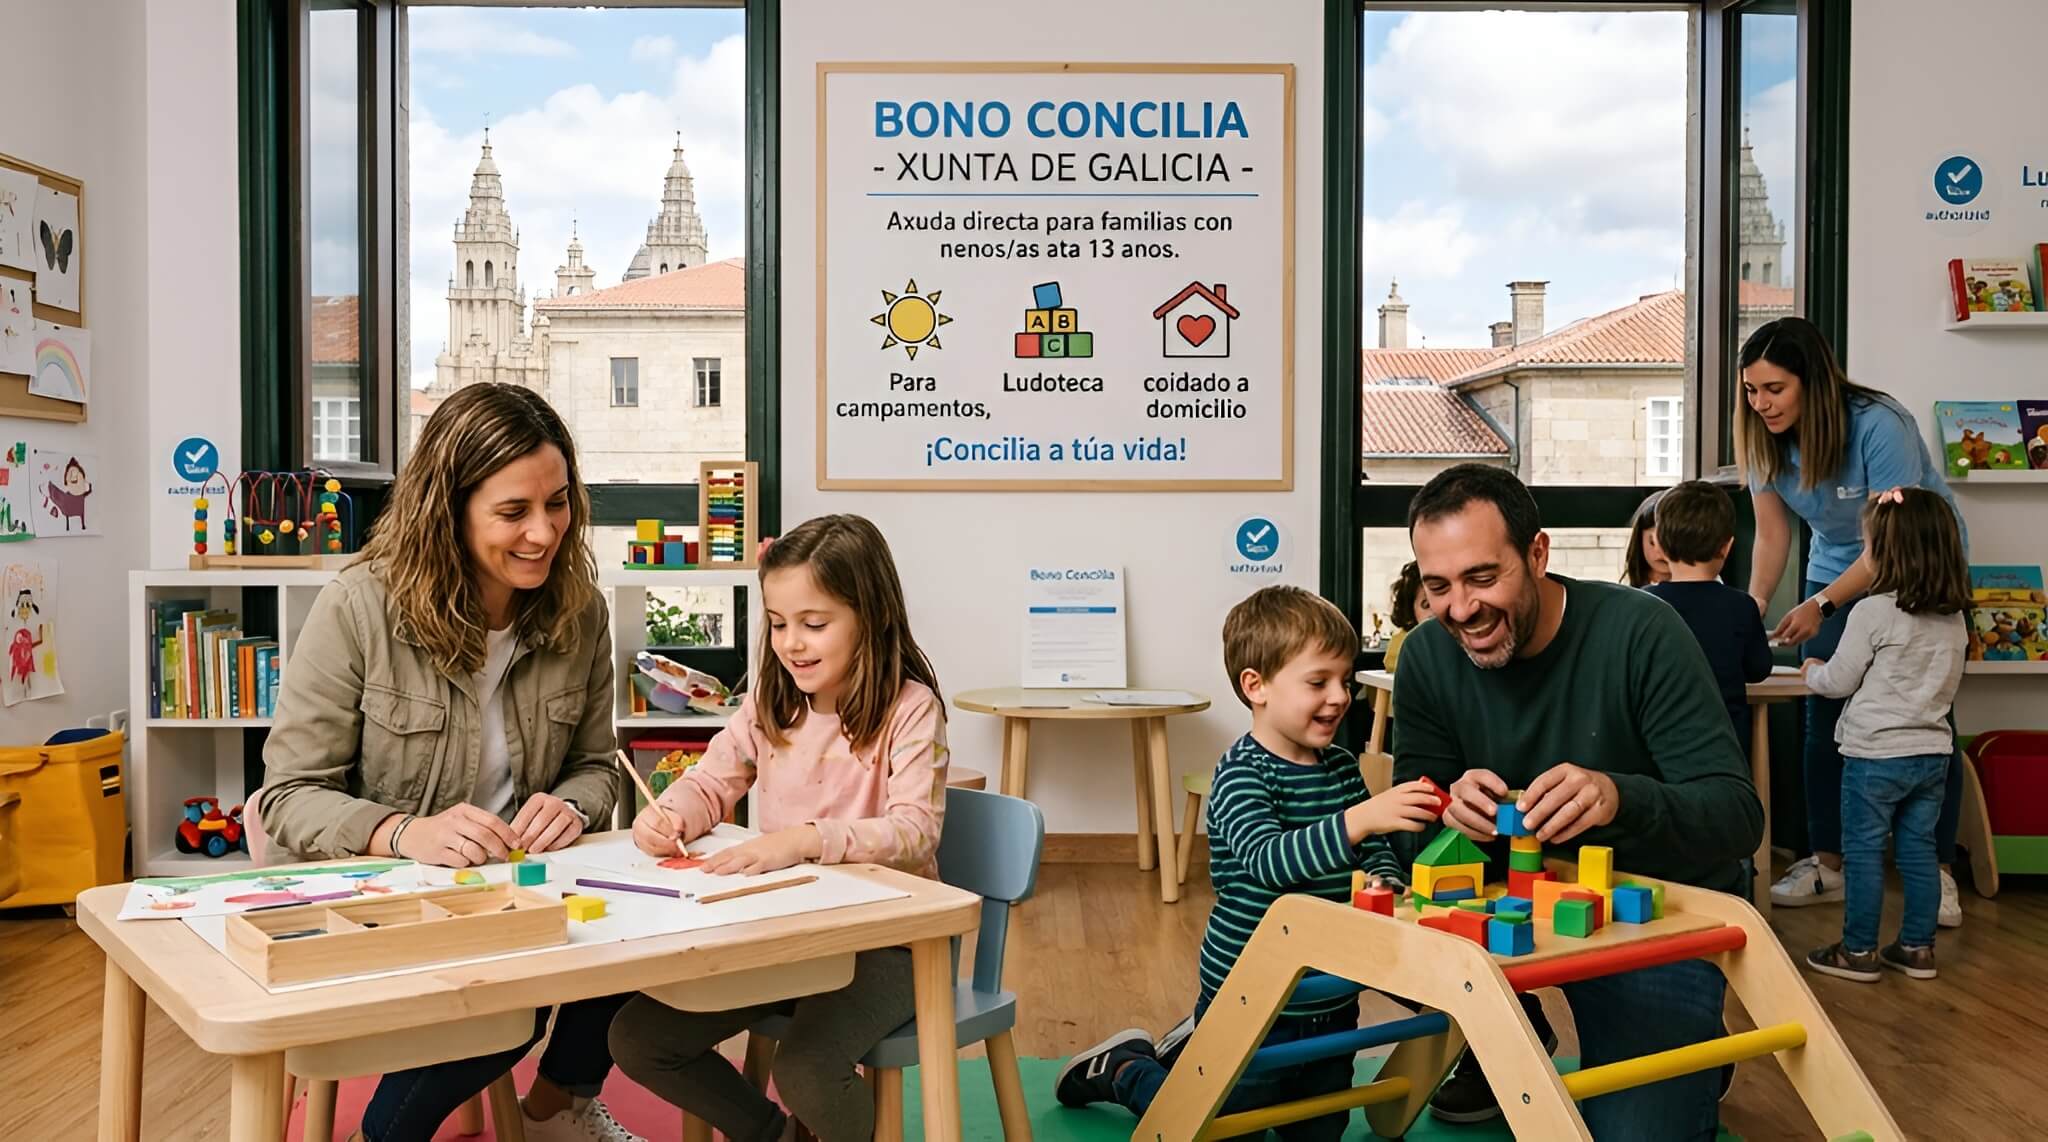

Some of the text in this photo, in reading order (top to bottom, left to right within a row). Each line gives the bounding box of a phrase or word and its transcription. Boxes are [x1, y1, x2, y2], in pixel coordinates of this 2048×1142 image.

[876, 101, 1248, 138] BONO CONCILIA
[897, 153, 1018, 181] XUNTA
[1032, 153, 1076, 181] DE
[1089, 153, 1230, 182] GALICIA
[887, 211, 1232, 235] Axuda directa para familias con
[941, 239, 1179, 259] nenos/as ata 13 anos.
[1032, 315, 1069, 328] A B
[1048, 339, 1060, 352] C
[891, 373, 936, 391] Para
[1004, 373, 1103, 392] Ludoteca
[1144, 372, 1248, 392] coidado a
[837, 400, 990, 422] campamentos,
[1147, 398, 1246, 418] domicilio
[927, 437, 1185, 466] ¡Concilia a túa vida!
